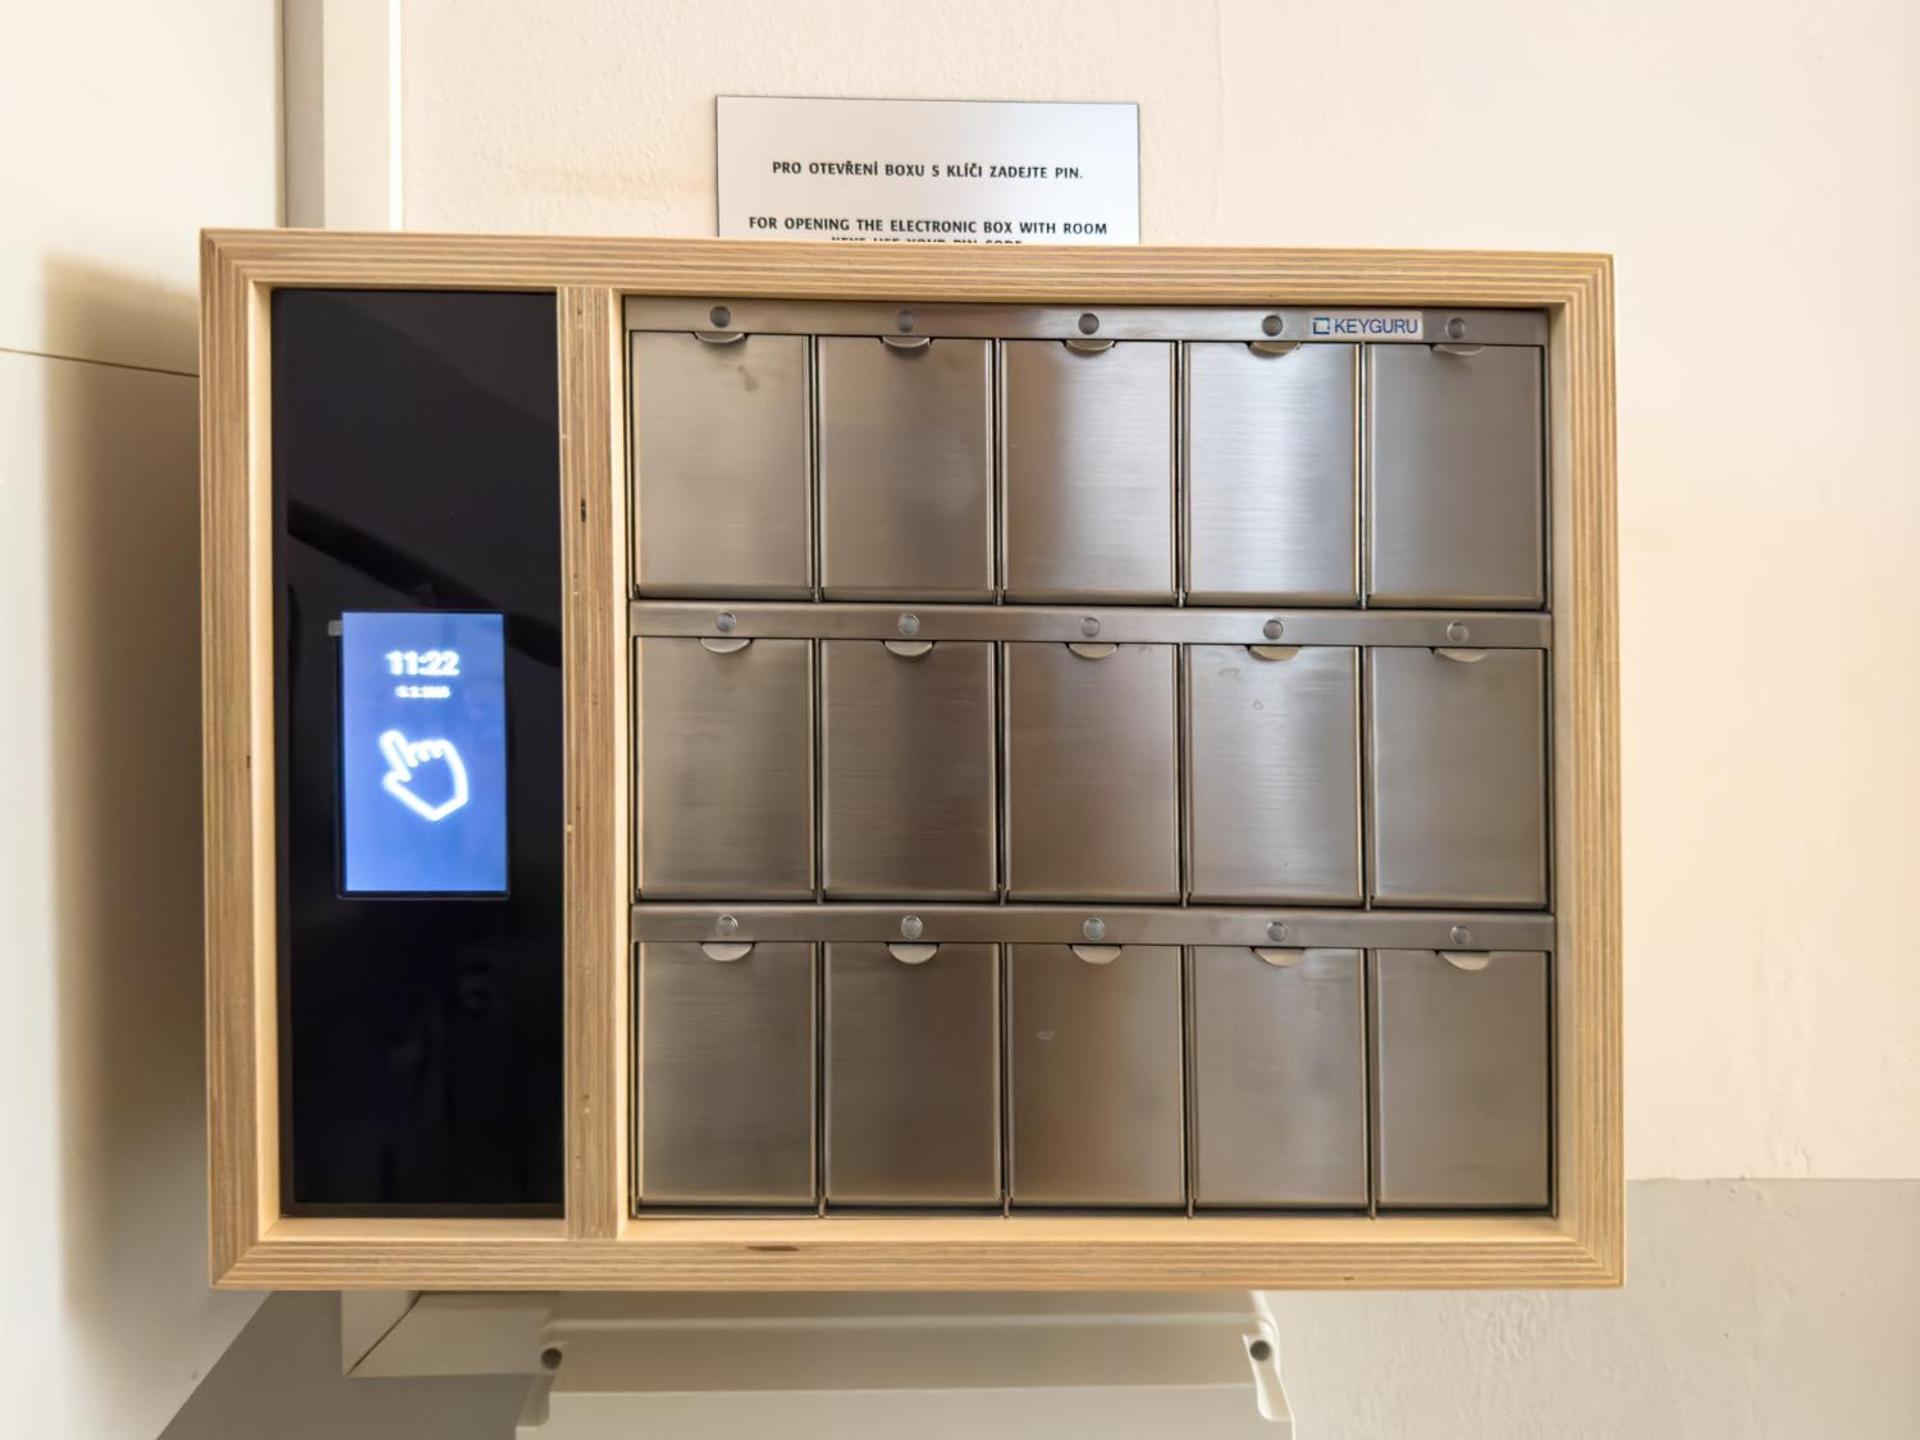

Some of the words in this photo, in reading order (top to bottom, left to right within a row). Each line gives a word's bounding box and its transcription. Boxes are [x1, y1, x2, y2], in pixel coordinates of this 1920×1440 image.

[772, 160, 803, 175] PRO
[808, 158, 879, 177] OTEVŘENÍ
[885, 163, 925, 178] BOXU
[931, 164, 940, 178] S
[946, 161, 983, 178] KLÍČI
[989, 165, 1048, 180] ZADEJTE
[1054, 166, 1084, 180] PIN.
[748, 216, 778, 230] FOR
[783, 217, 850, 231] OPENING
[856, 218, 883, 232] THE
[890, 219, 977, 234] ELECTRONIC
[983, 220, 1013, 234] BOX
[1019, 221, 1056, 235] WITH
[1062, 222, 1108, 235] ROOM
[1334, 318, 1418, 334] KEYGURU
[385, 649, 461, 676] 11:22
